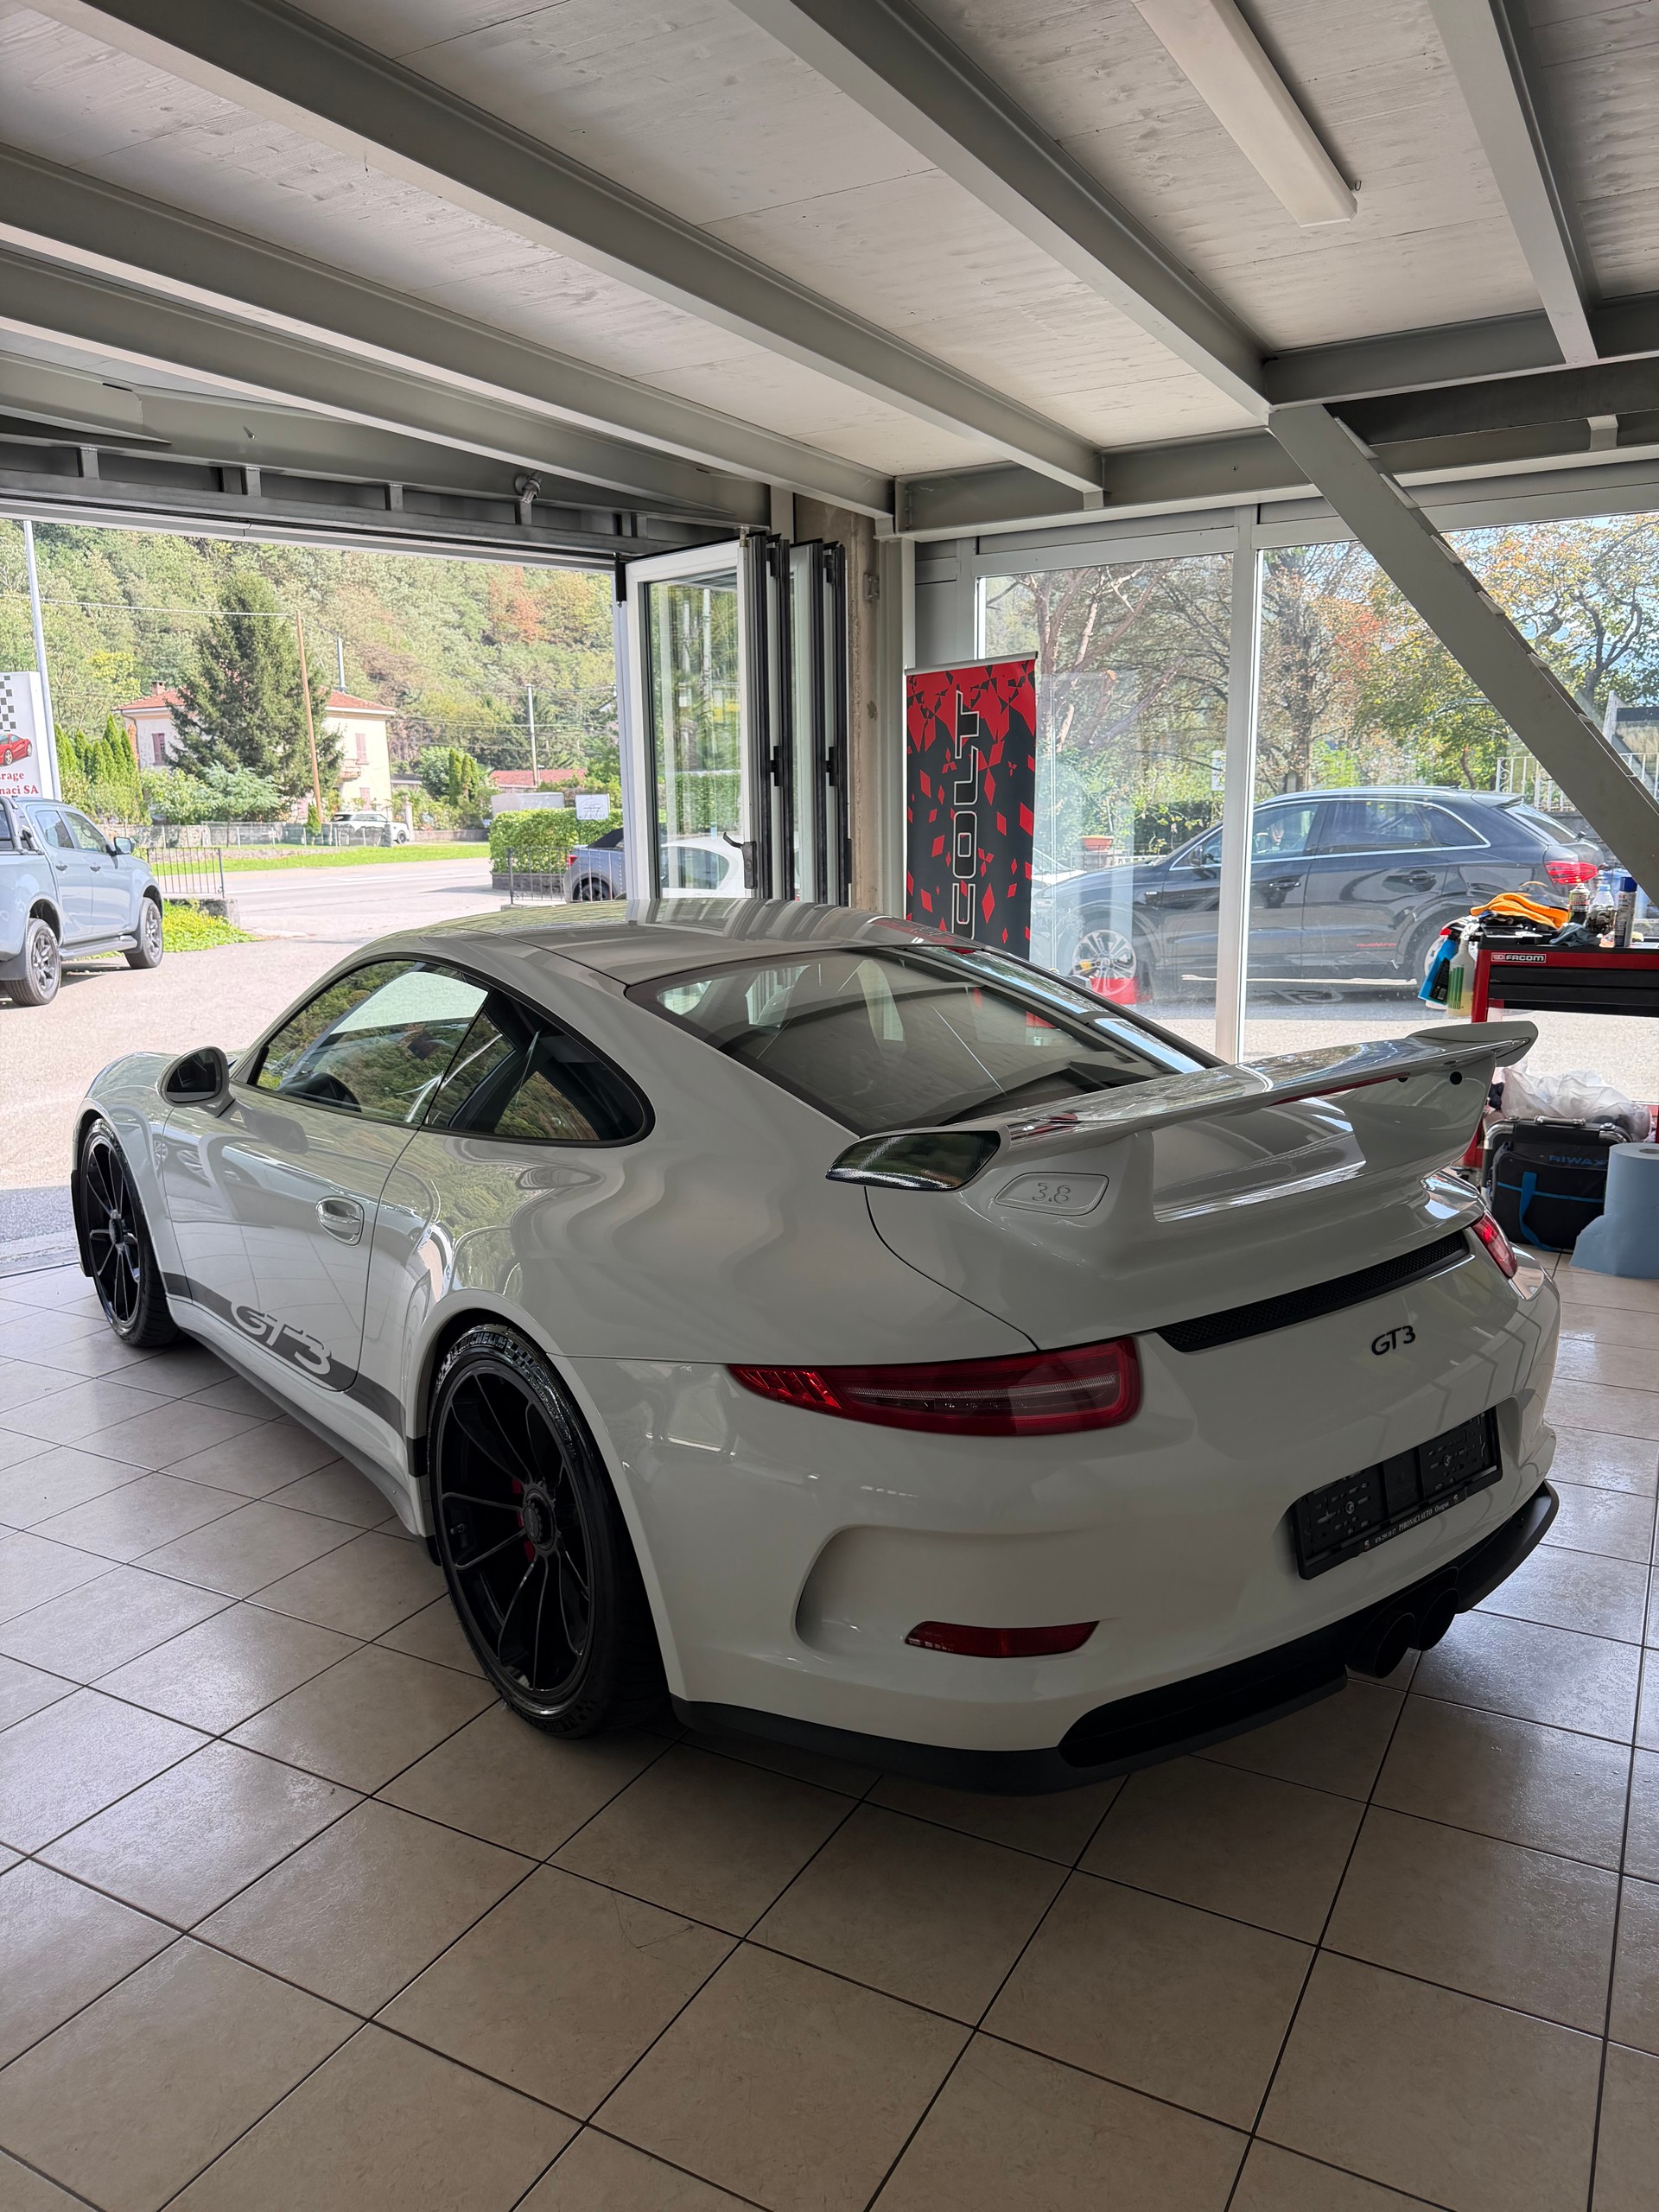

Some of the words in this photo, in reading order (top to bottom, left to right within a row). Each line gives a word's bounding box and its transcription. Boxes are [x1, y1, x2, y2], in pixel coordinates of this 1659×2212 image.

[0, 772, 24, 782] rage
[23, 785, 39, 794] SA
[951, 690, 980, 941] COLT
[1548, 1154, 1604, 1166] RIWAX
[1032, 1182, 1071, 1204] 3.8
[231, 1301, 333, 1376] GT3
[1370, 1325, 1416, 1356] GT3
